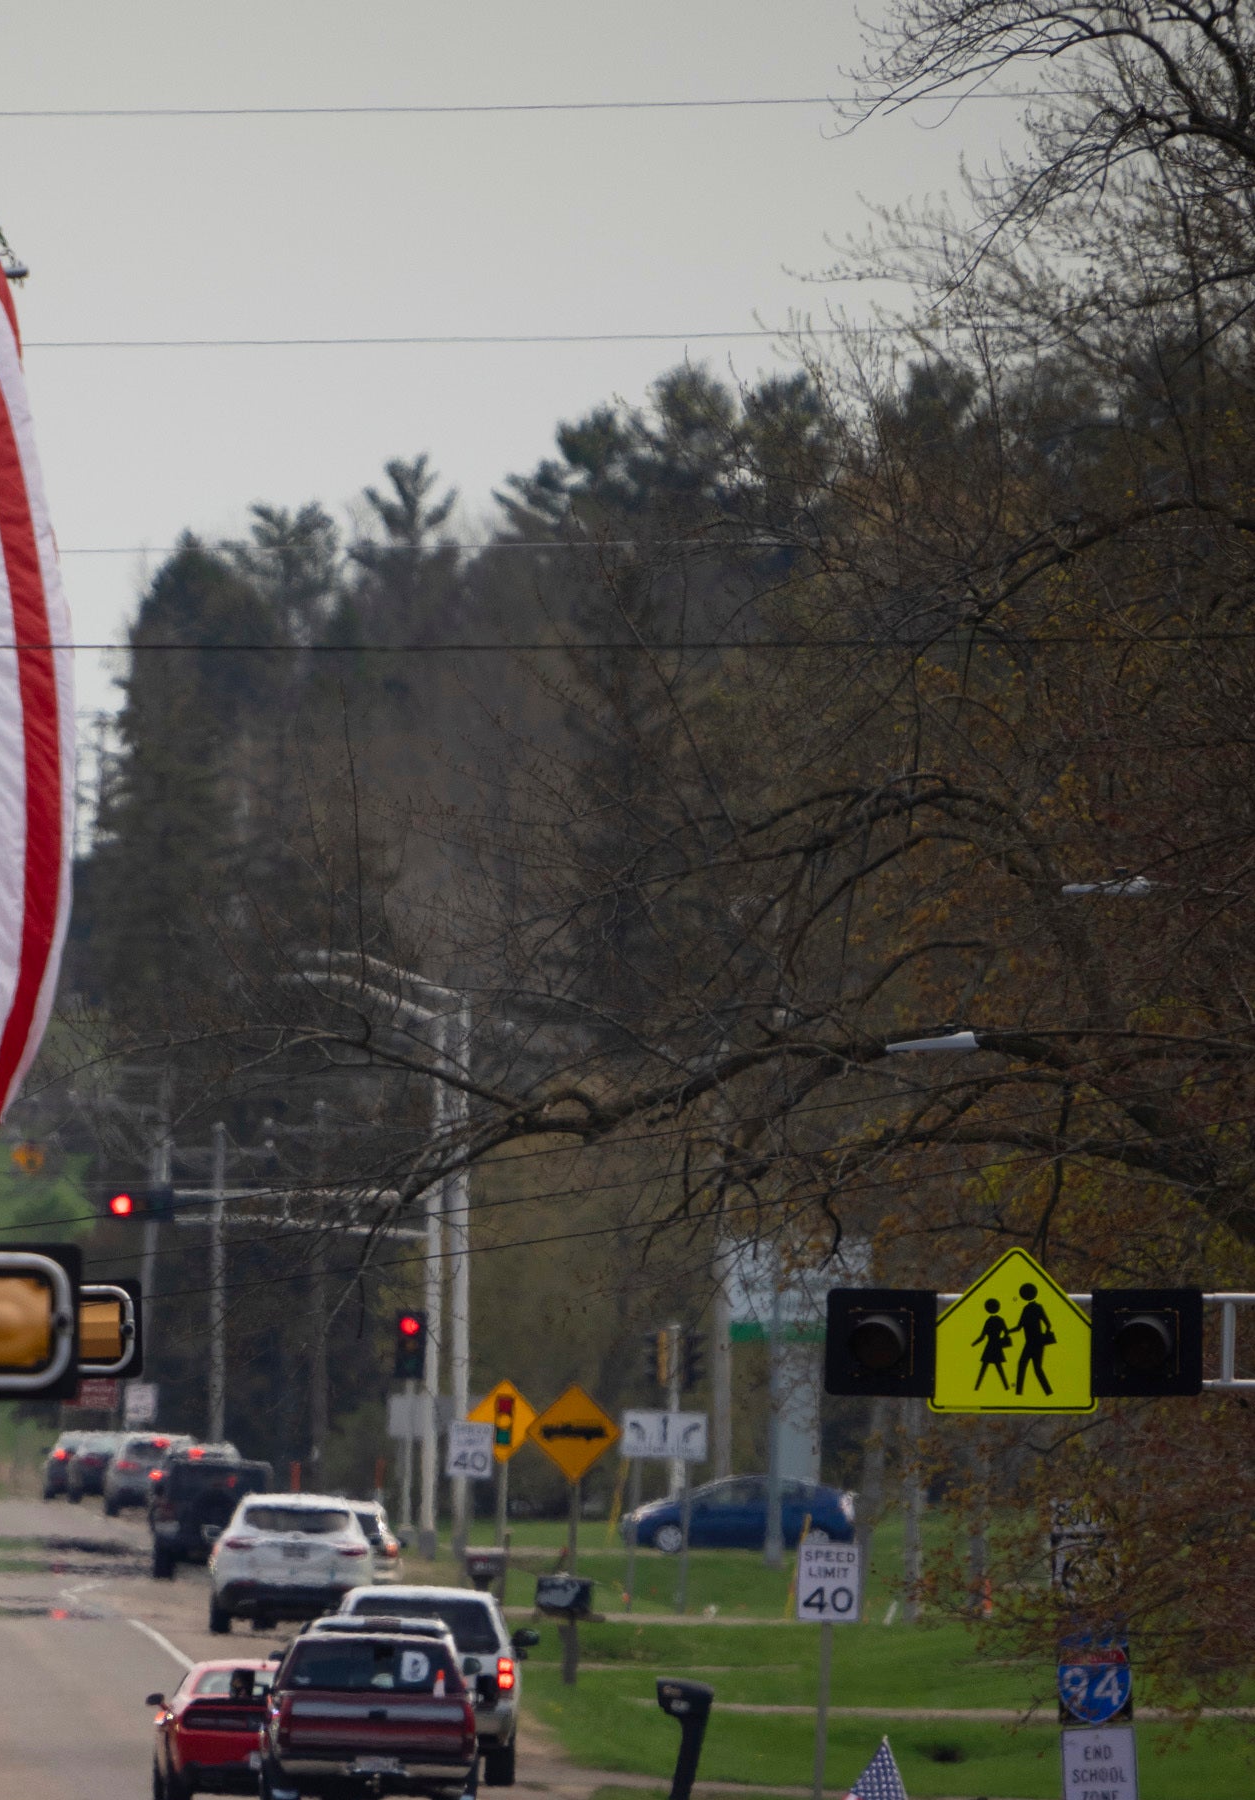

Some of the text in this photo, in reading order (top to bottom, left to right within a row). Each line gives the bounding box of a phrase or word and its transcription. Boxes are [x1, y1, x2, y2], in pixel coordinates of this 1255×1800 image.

[454, 1451, 488, 1473] 40
[805, 1550, 856, 1563] SPEED
[808, 1567, 849, 1578] LIMIT
[803, 1586, 854, 1613] 40
[1063, 1667, 1123, 1707] 94
[1084, 1745, 1113, 1761] END
[1072, 1767, 1127, 1784] SCHOOL
